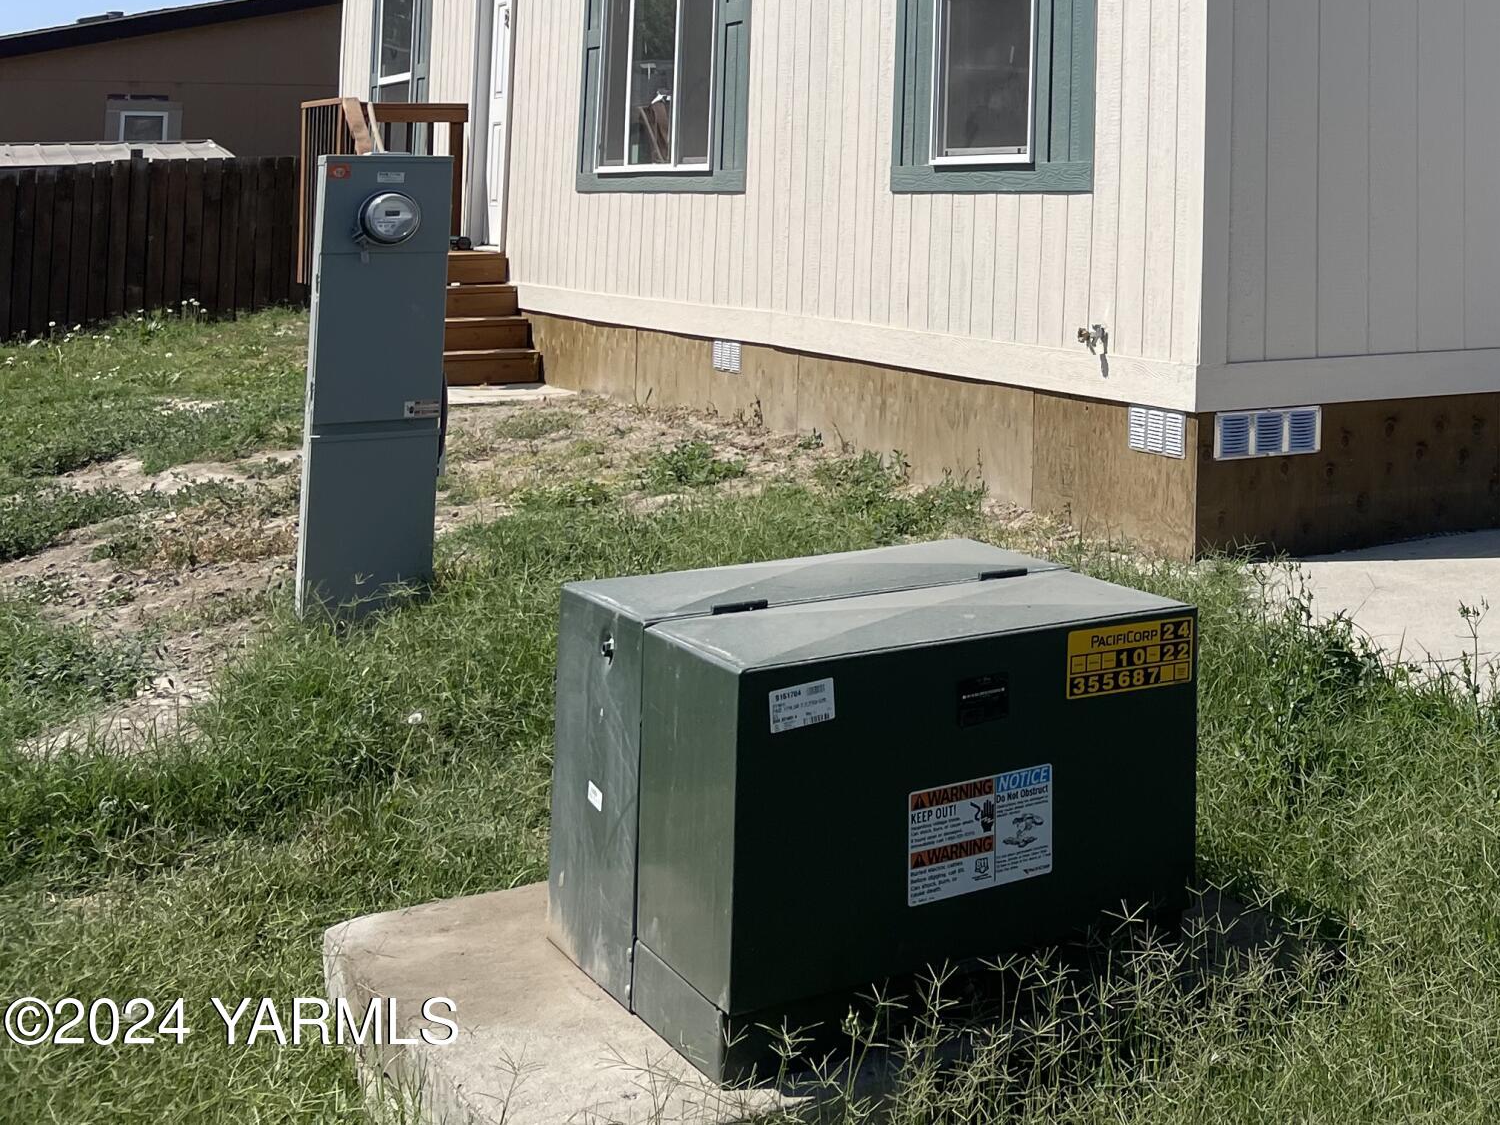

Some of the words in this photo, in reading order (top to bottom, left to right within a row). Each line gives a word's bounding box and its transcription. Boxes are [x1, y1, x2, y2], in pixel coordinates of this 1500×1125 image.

[1072, 667, 1160, 695] 355687
[998, 767, 1049, 791] NOTICE
[927, 779, 992, 807] WARNING
[996, 794, 1006, 804] Do
[1007, 791, 1019, 801] Not
[1021, 785, 1049, 798] Obstruct
[911, 810, 934, 825] KEEP
[935, 804, 957, 819] OUT!
[927, 837, 992, 865] WARNING
